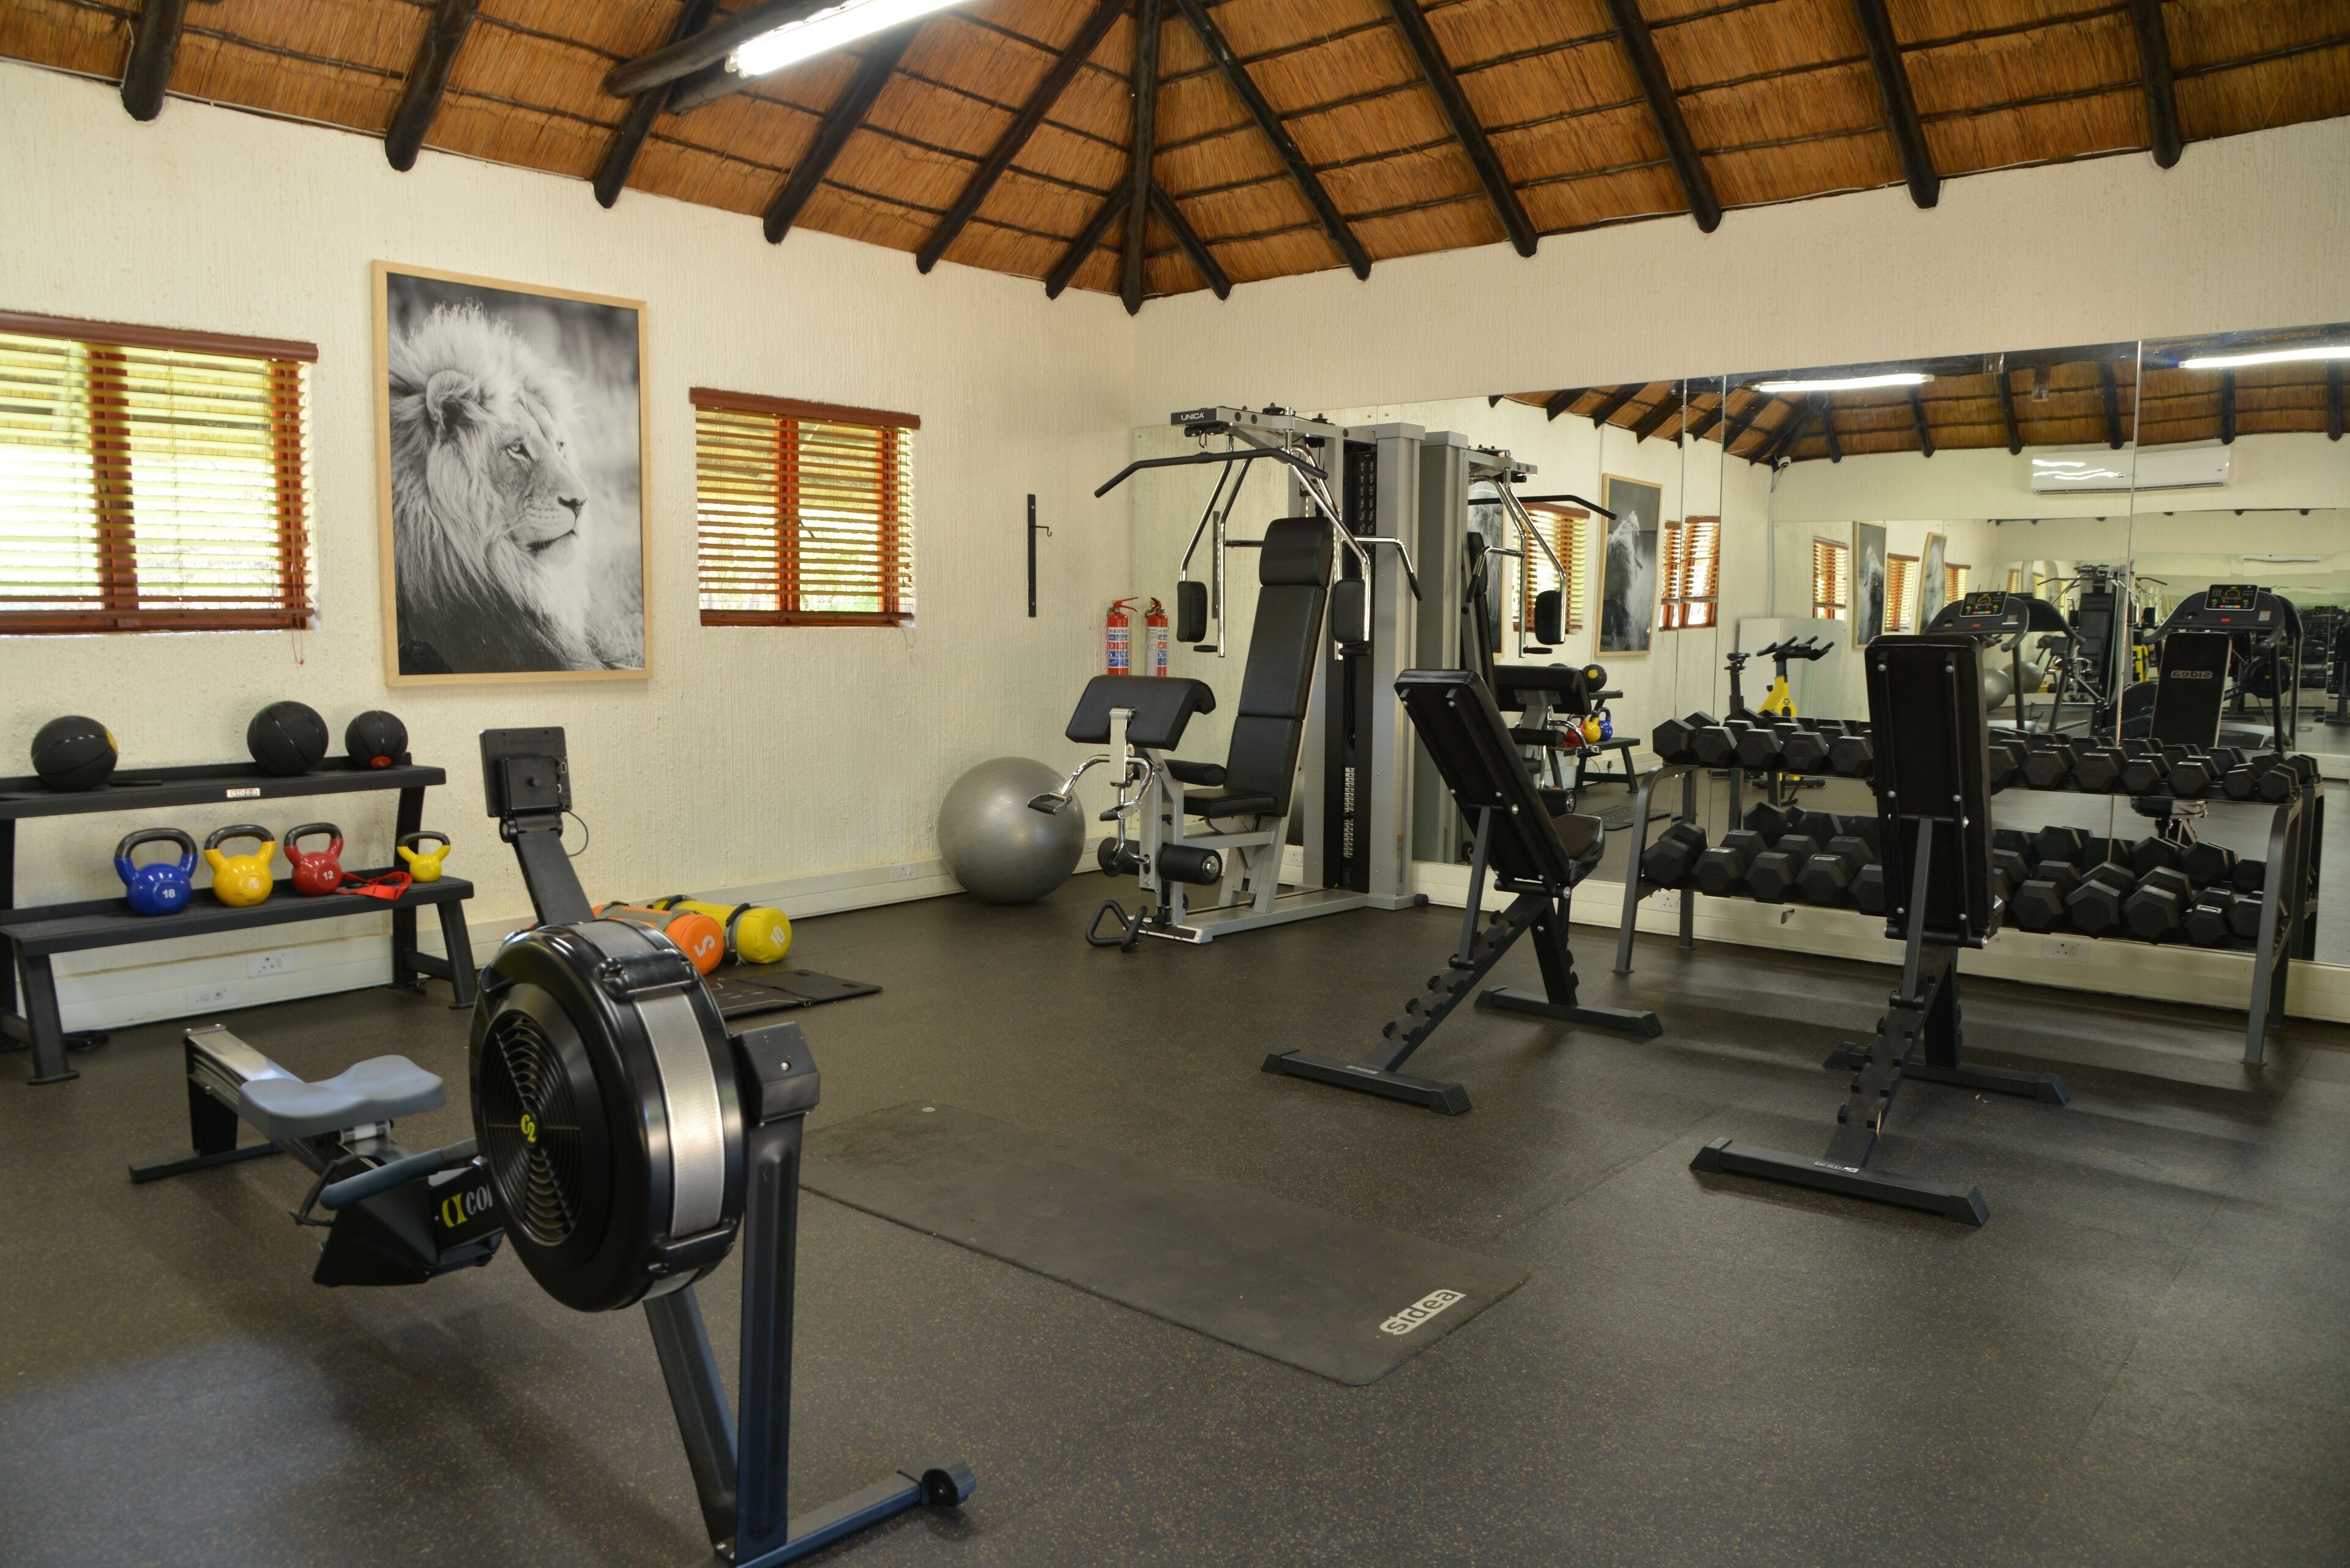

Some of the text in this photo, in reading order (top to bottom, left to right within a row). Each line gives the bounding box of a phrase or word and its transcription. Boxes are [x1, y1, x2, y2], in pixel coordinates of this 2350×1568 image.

[1181, 412, 1204, 420] UNICA
[323, 870, 334, 880] 12
[248, 881, 259, 890] 16
[162, 889, 176, 898] 18
[770, 925, 786, 949] 10
[1387, 1291, 1459, 1332] sidea
